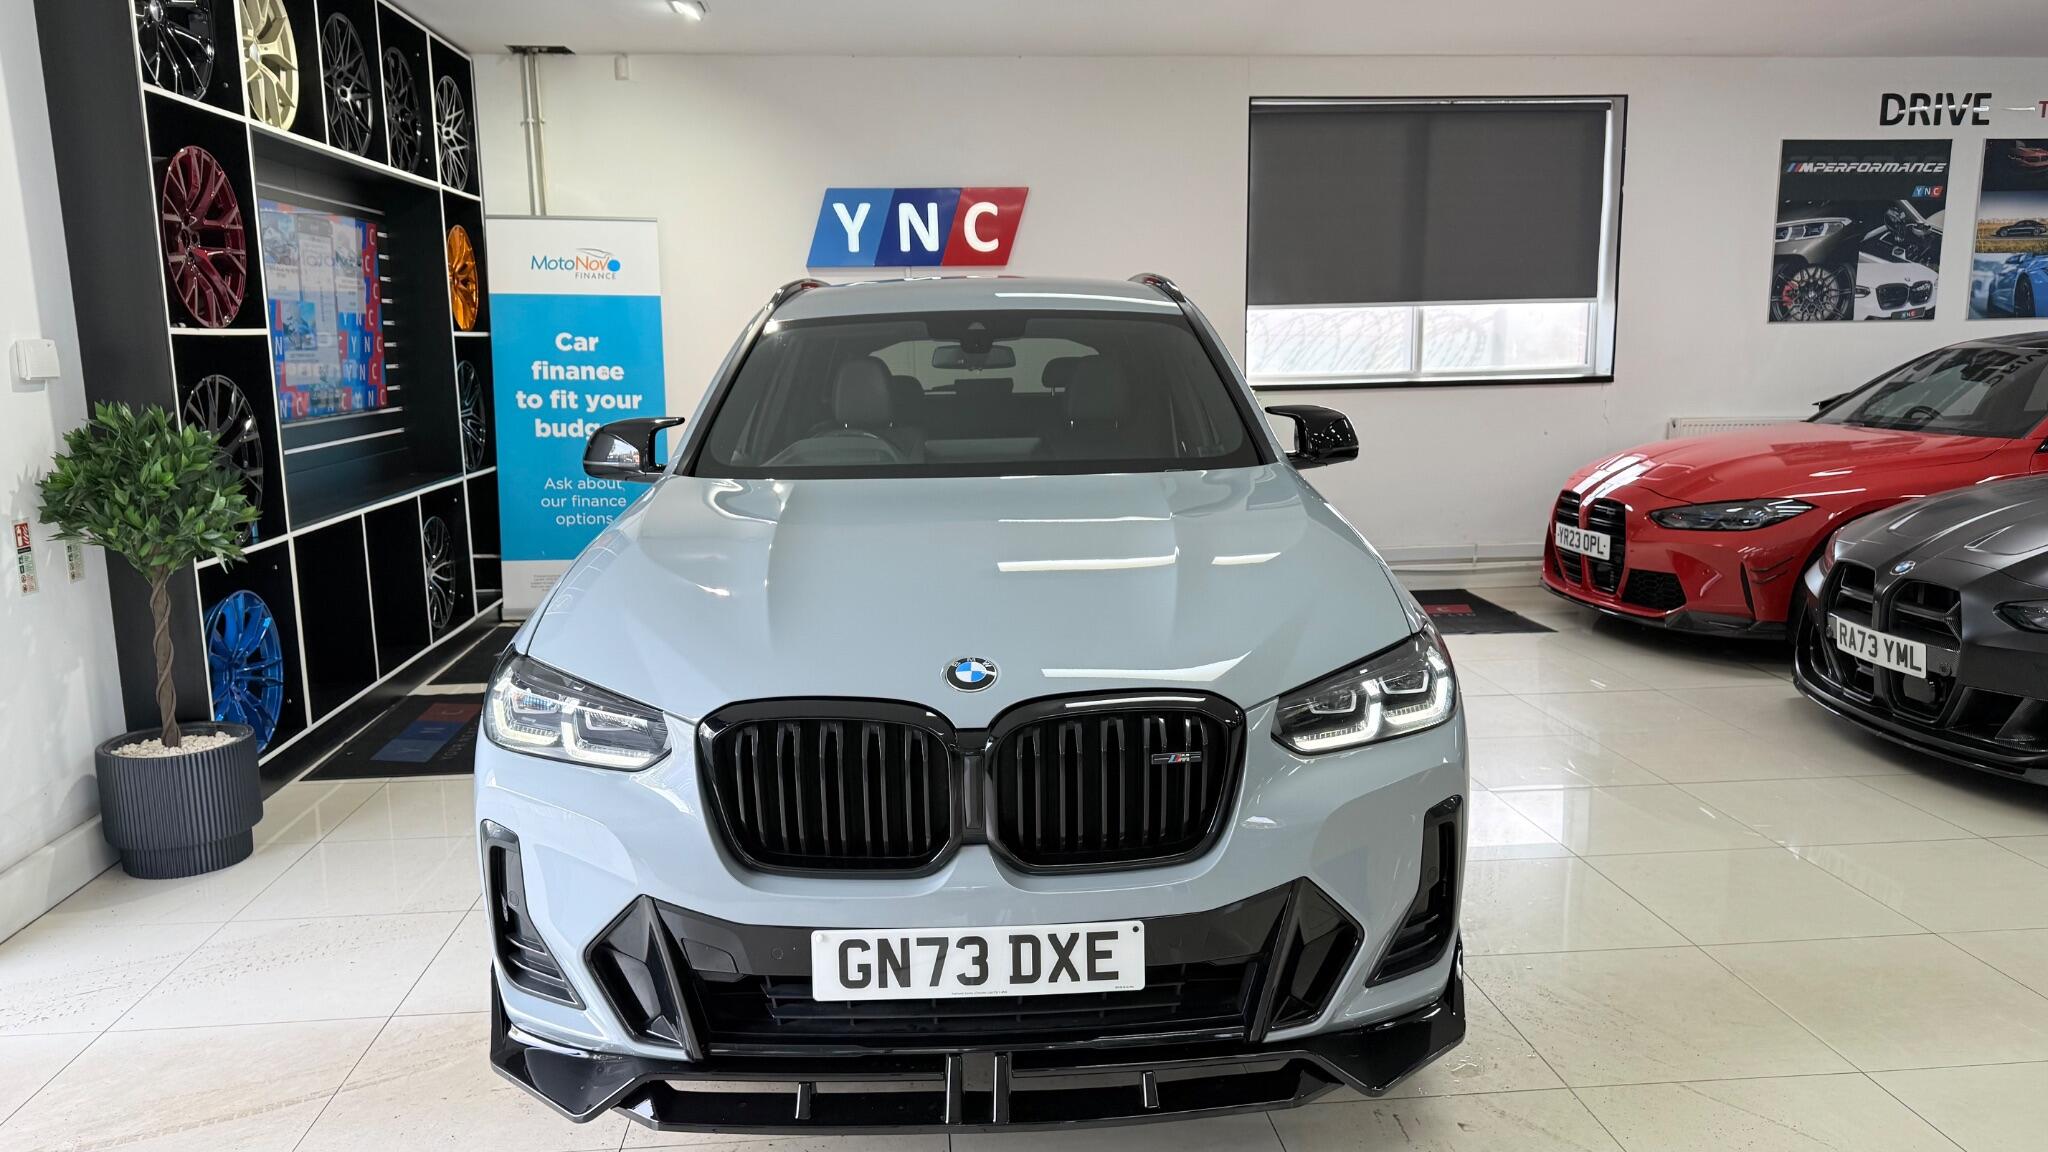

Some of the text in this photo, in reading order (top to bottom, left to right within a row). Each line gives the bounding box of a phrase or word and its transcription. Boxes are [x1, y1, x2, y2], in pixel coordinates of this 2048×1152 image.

[1879, 92, 1992, 126] DRIVE
[1915, 186, 1941, 196] YNC
[832, 201, 1000, 253] YNC
[575, 272, 617, 280] FINANCE
[555, 332, 600, 352] Car
[531, 360, 625, 381] finance
[515, 389, 643, 413] to fit your
[544, 476, 573, 490] Ask
[541, 494, 627, 508] our finance
[1559, 526, 1604, 555] YR23 OPL
[1839, 621, 1922, 673] RA73 YML
[838, 930, 1120, 990] GN73 DXE
